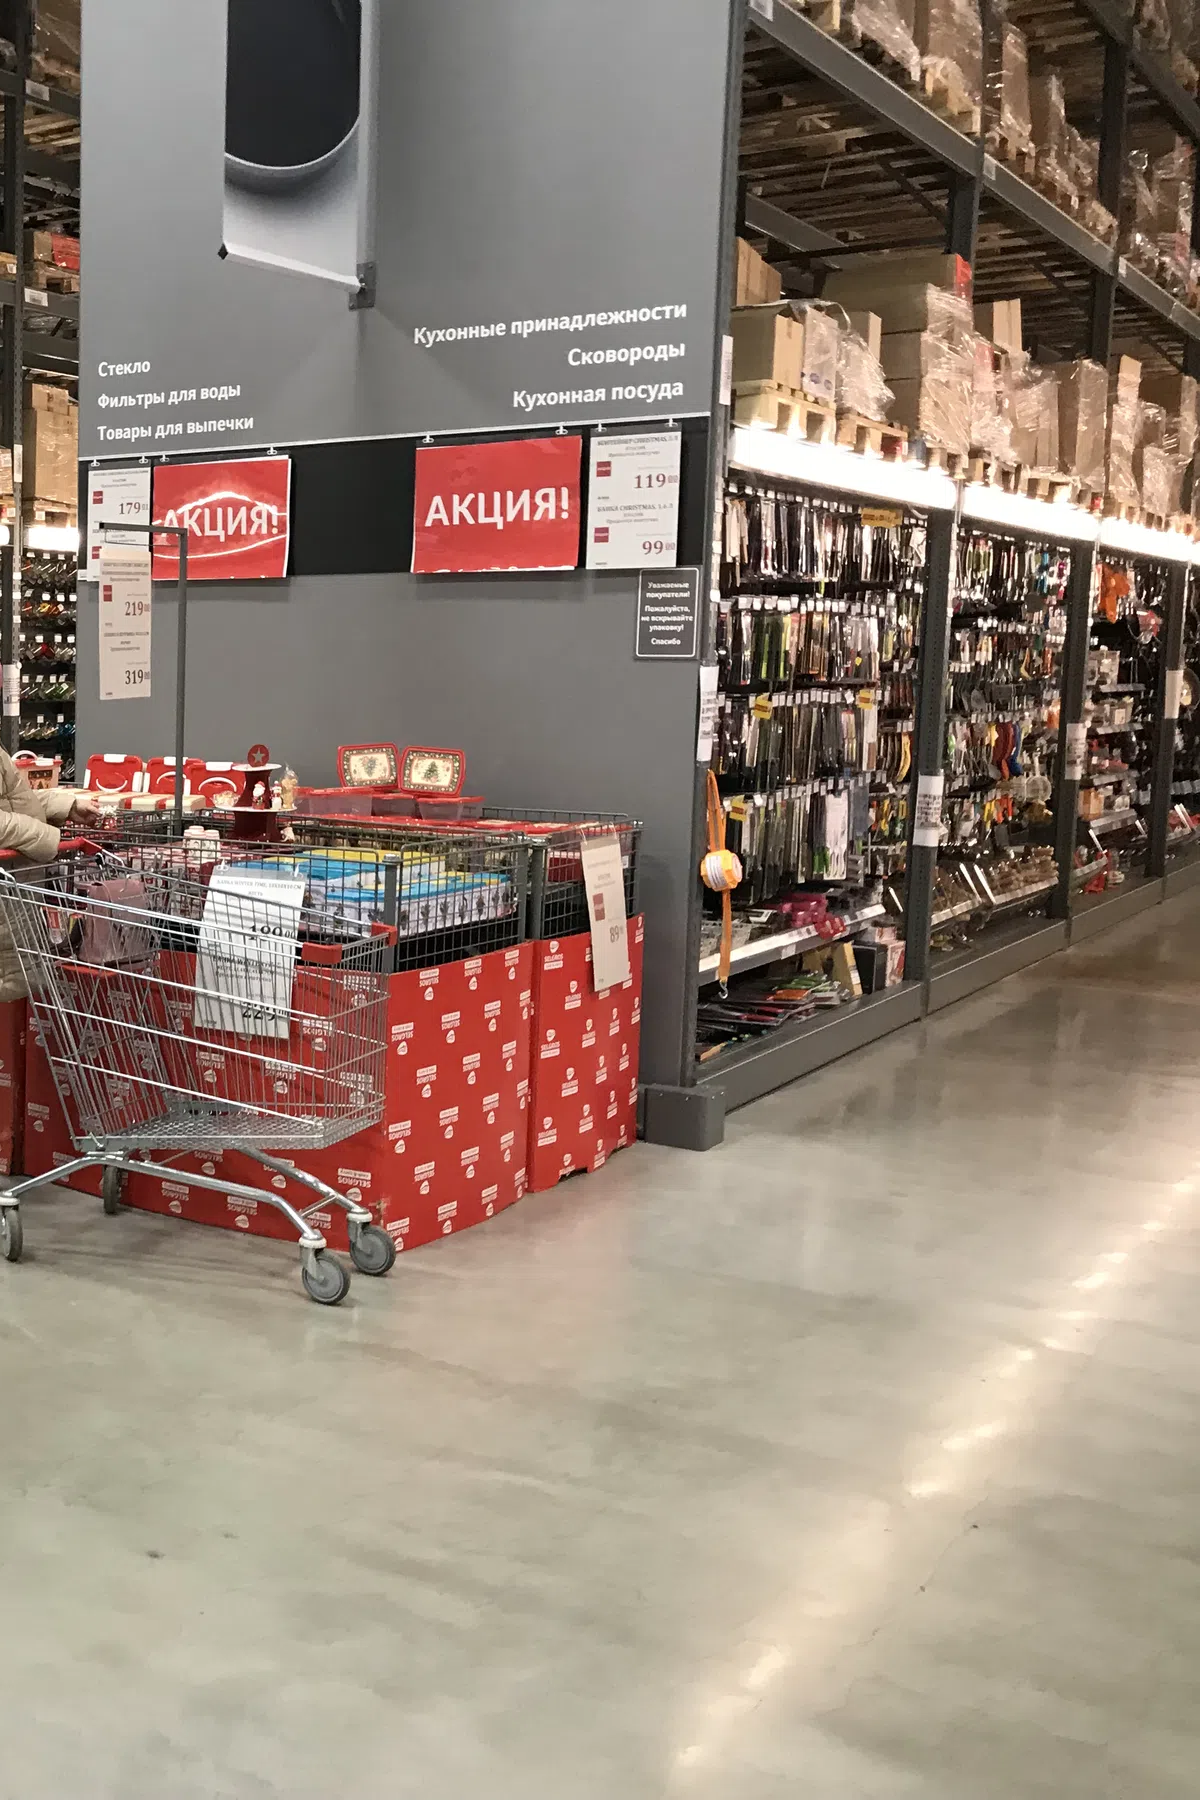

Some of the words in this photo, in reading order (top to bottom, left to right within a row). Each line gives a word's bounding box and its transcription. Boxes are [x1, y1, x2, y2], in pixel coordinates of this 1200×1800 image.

[414, 321, 506, 347] Кухонные
[511, 303, 687, 337] принадлежности
[567, 342, 685, 366] Сковороды
[98, 360, 151, 377] Стекло
[98, 391, 165, 409] Фильтры
[168, 387, 197, 405] для
[200, 384, 241, 402] воды
[513, 386, 606, 411] Кухонная
[611, 381, 684, 402] посуда
[97, 423, 152, 442] Товары
[155, 421, 183, 439] для
[187, 416, 254, 434] выпечки
[634, 473, 666, 489] 119
[118, 501, 141, 515] 179
[425, 486, 569, 530] АКЦИЯ!
[161, 505, 279, 543] АКЦИЯ!
[642, 540, 663, 555] 99
[648, 581, 689, 590] Уважаемые
[645, 590, 690, 600] покупатели!
[125, 601, 144, 616] 219
[644, 604, 690, 614] Пожалуйста,
[651, 613, 693, 624] вскрывайте
[649, 623, 684, 633] упаковку!
[651, 636, 681, 646] Спасибо
[125, 669, 144, 685] 319
[609, 925, 620, 943] 89
[337, 1176, 371, 1188] SELGROS
